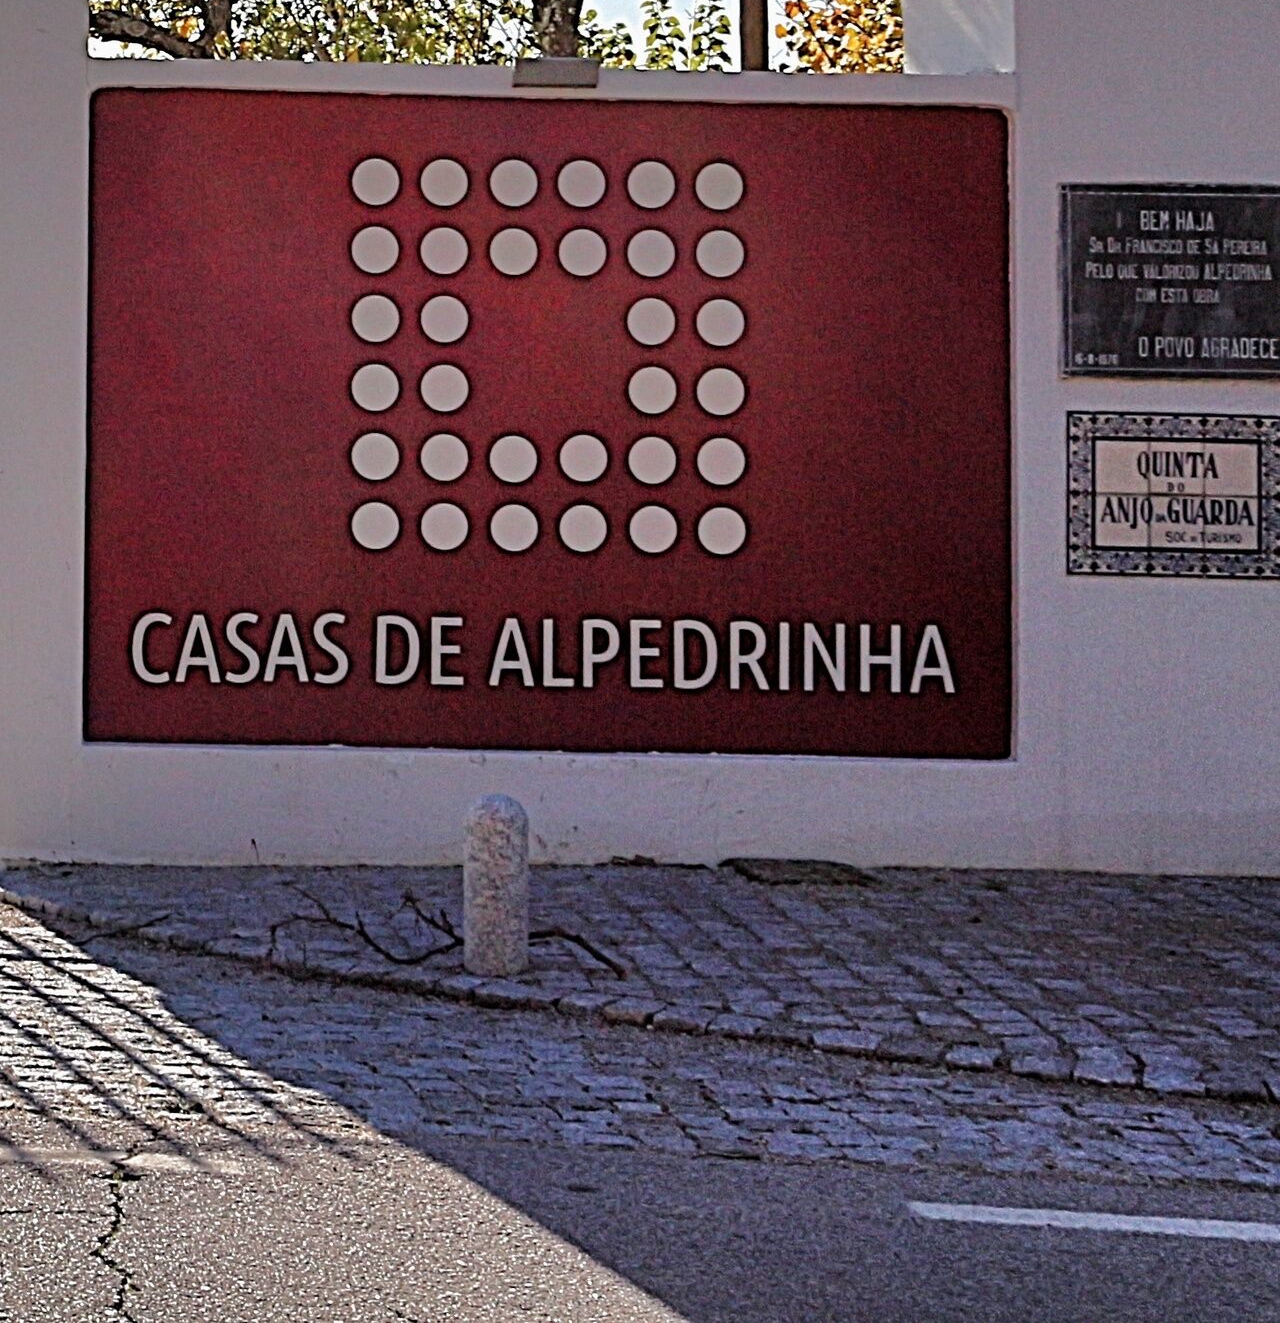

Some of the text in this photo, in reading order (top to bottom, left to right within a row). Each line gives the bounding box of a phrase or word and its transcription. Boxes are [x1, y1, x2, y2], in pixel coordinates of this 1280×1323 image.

[1140, 210, 1215, 231] BEM HAJA
[1125, 237, 1183, 254] FRANCISCO
[1187, 239, 1201, 254] DE
[1223, 238, 1268, 255] PEREIRA
[1085, 261, 1273, 280] PELO QUE VALORIZOU ALPEDRINHA
[1136, 288, 1220, 304] COM ESTA OBRA
[1138, 336, 1280, 359] O POVO AGRADECE
[1137, 451, 1219, 479] QUINTA
[1167, 482, 1185, 493] DO
[1101, 496, 1153, 529] ANJO
[1167, 497, 1255, 527] GUARDA
[1200, 531, 1243, 544] TURISMO
[131, 612, 956, 694] CASAS DE ALPEDRINHA
